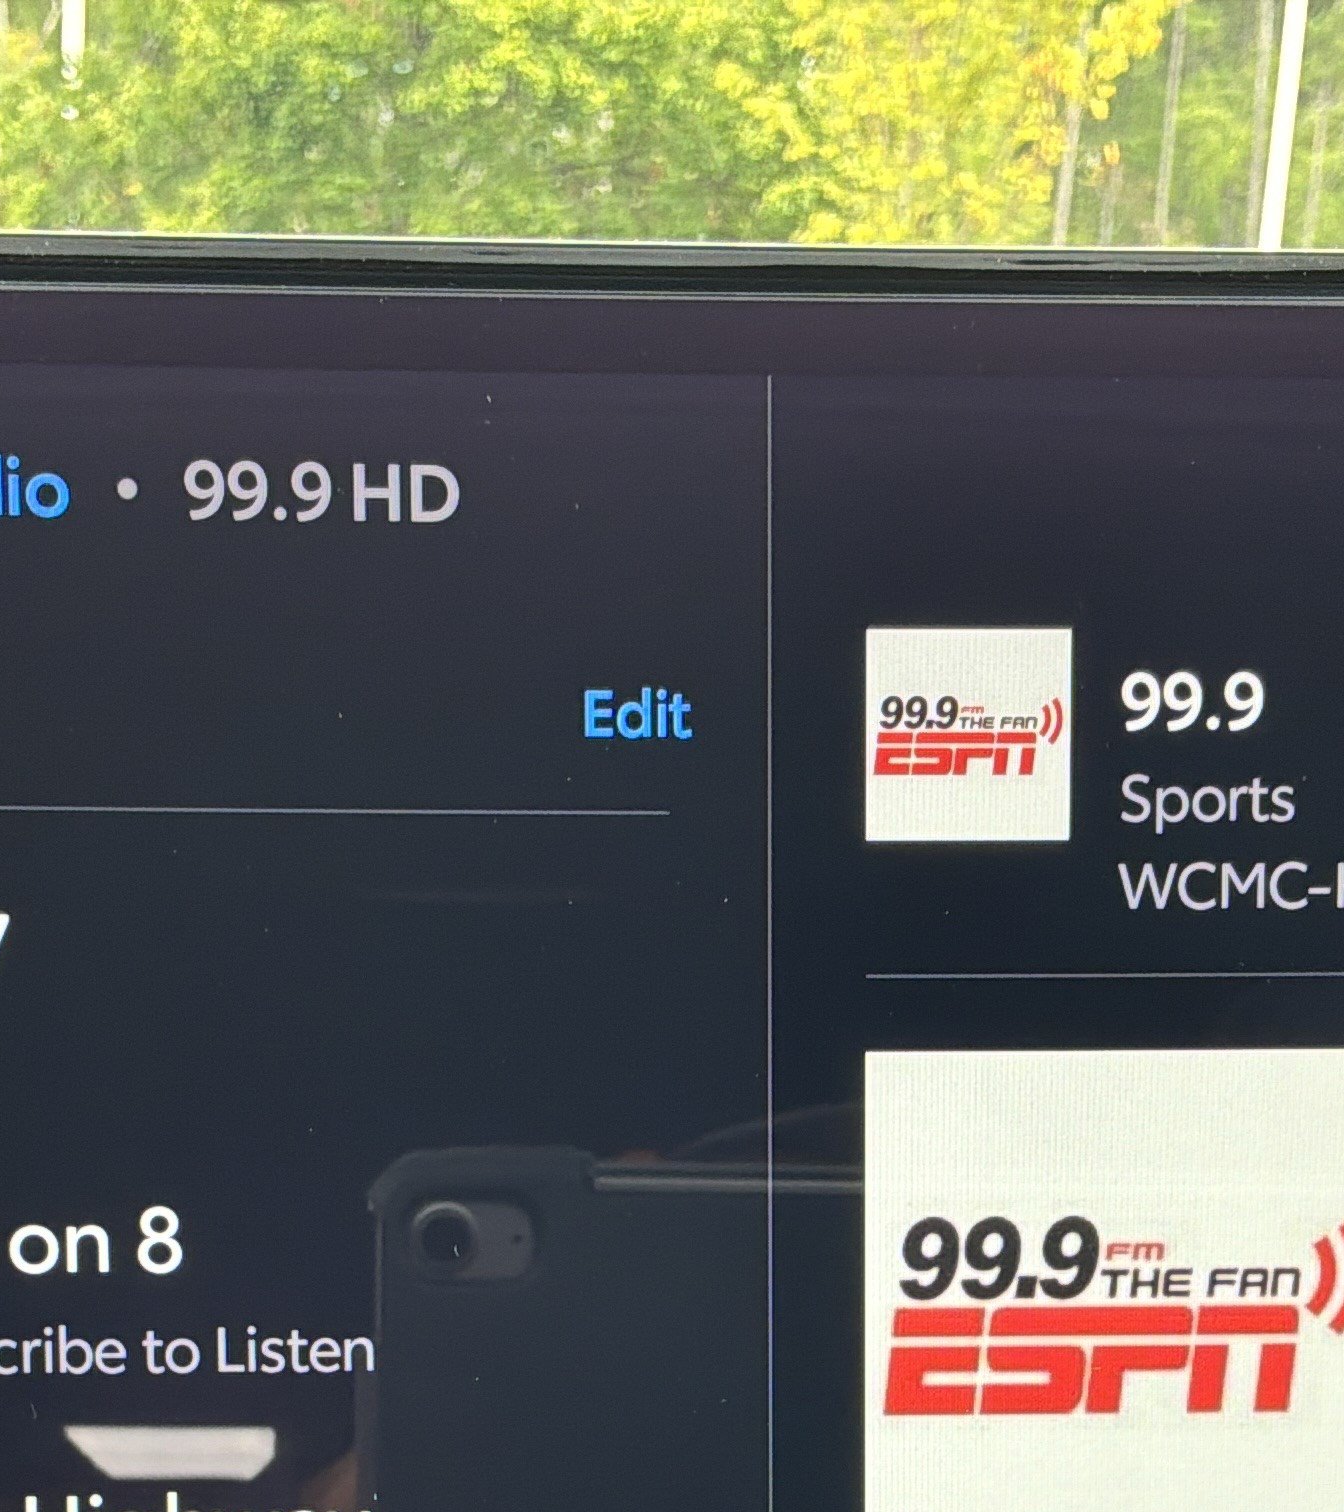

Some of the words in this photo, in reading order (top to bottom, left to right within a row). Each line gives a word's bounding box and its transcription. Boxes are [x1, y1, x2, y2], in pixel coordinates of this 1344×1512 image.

[183, 459, 333, 523] 99.9
[352, 462, 460, 523] HD
[584, 686, 693, 740] Edit
[880, 696, 959, 729] 99.9
[959, 716, 994, 729] THE
[1000, 716, 1038, 729] FAN
[1121, 670, 1264, 732] 99.9
[874, 732, 1036, 775] ESPN
[1120, 773, 1296, 834] Sports
[8, 1224, 110, 1275] on
[137, 1205, 183, 1275] 8
[899, 1216, 1100, 1300] 99.9
[1105, 1242, 1165, 1261] FM
[1101, 1268, 1193, 1298] THE
[1206, 1267, 1301, 1297] FAN
[141, 1330, 201, 1375] to
[217, 1325, 375, 1374] Listen
[883, 1305, 1299, 1415] ESPN
